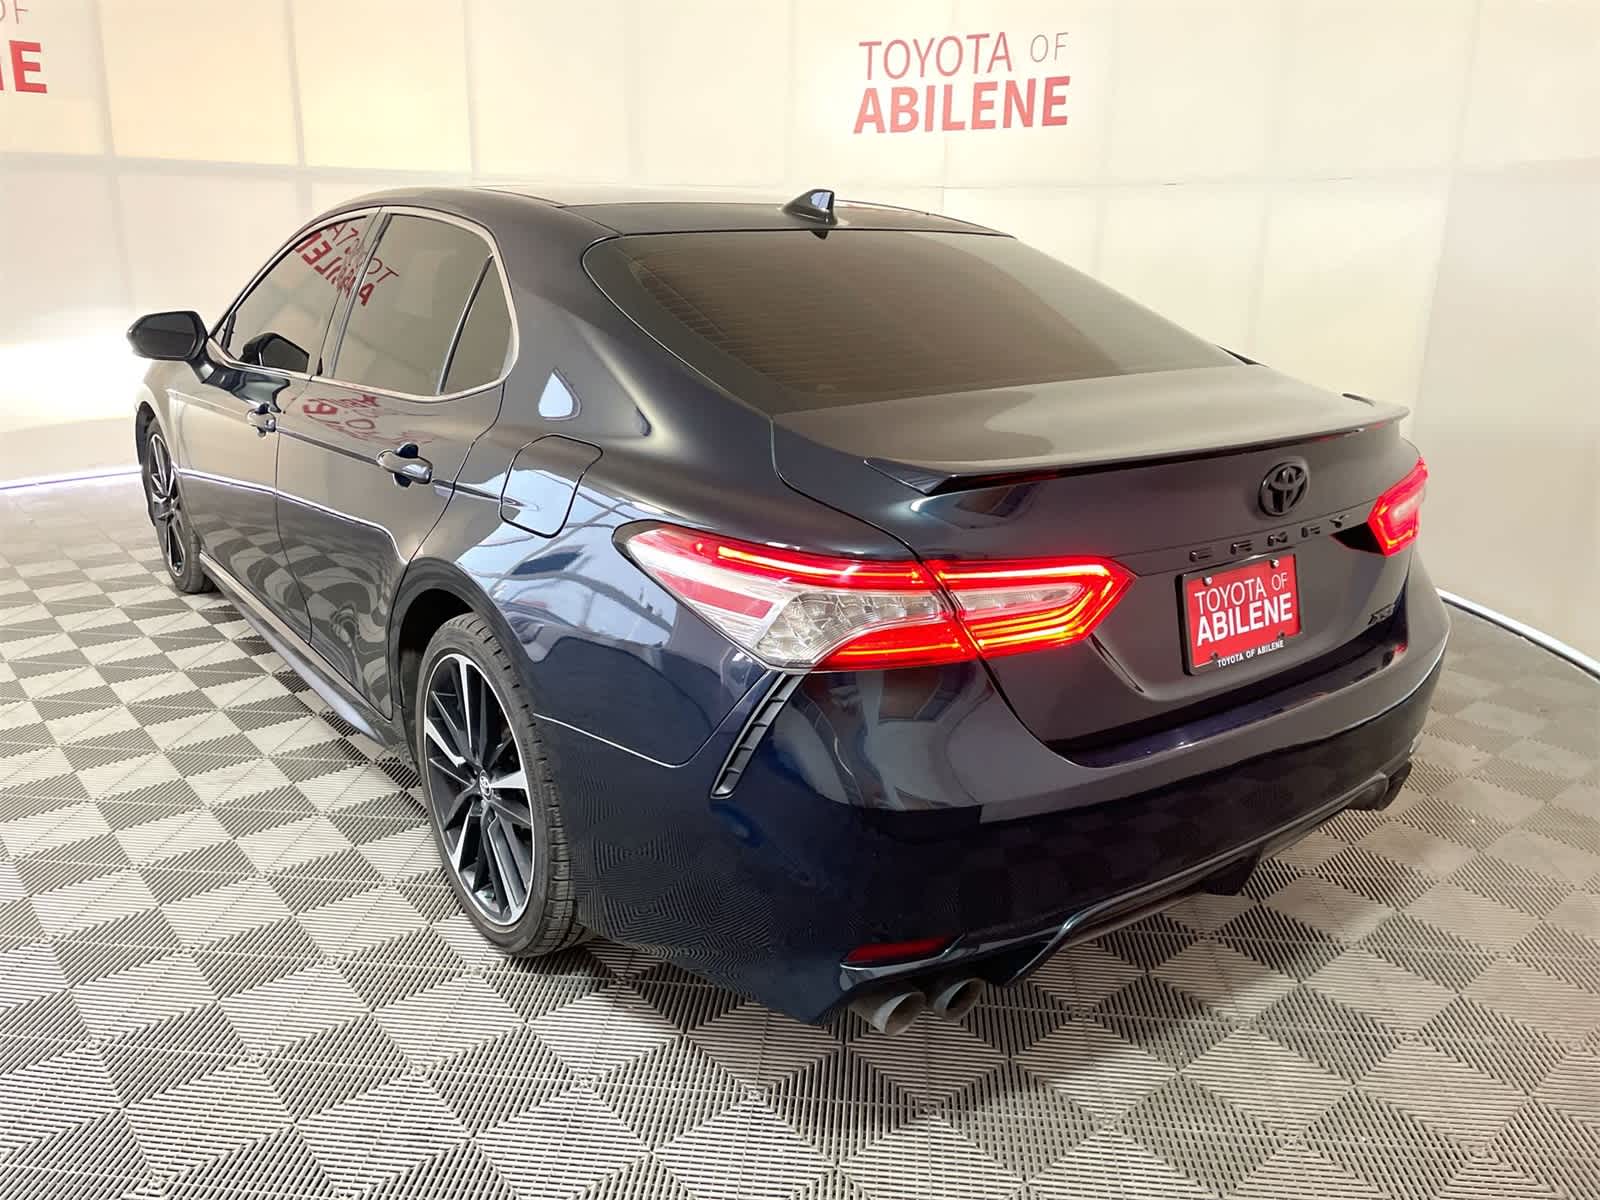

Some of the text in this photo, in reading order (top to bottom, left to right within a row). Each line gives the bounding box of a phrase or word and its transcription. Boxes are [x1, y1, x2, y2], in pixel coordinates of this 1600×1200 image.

[859, 31, 1069, 80] TOYOTA OF
[853, 76, 1070, 134] ABILENE
[1194, 572, 1288, 614] TOYOTA OF
[1197, 592, 1293, 646] ABILENE
[1217, 640, 1284, 667] TOYOTA OF ABILENE
